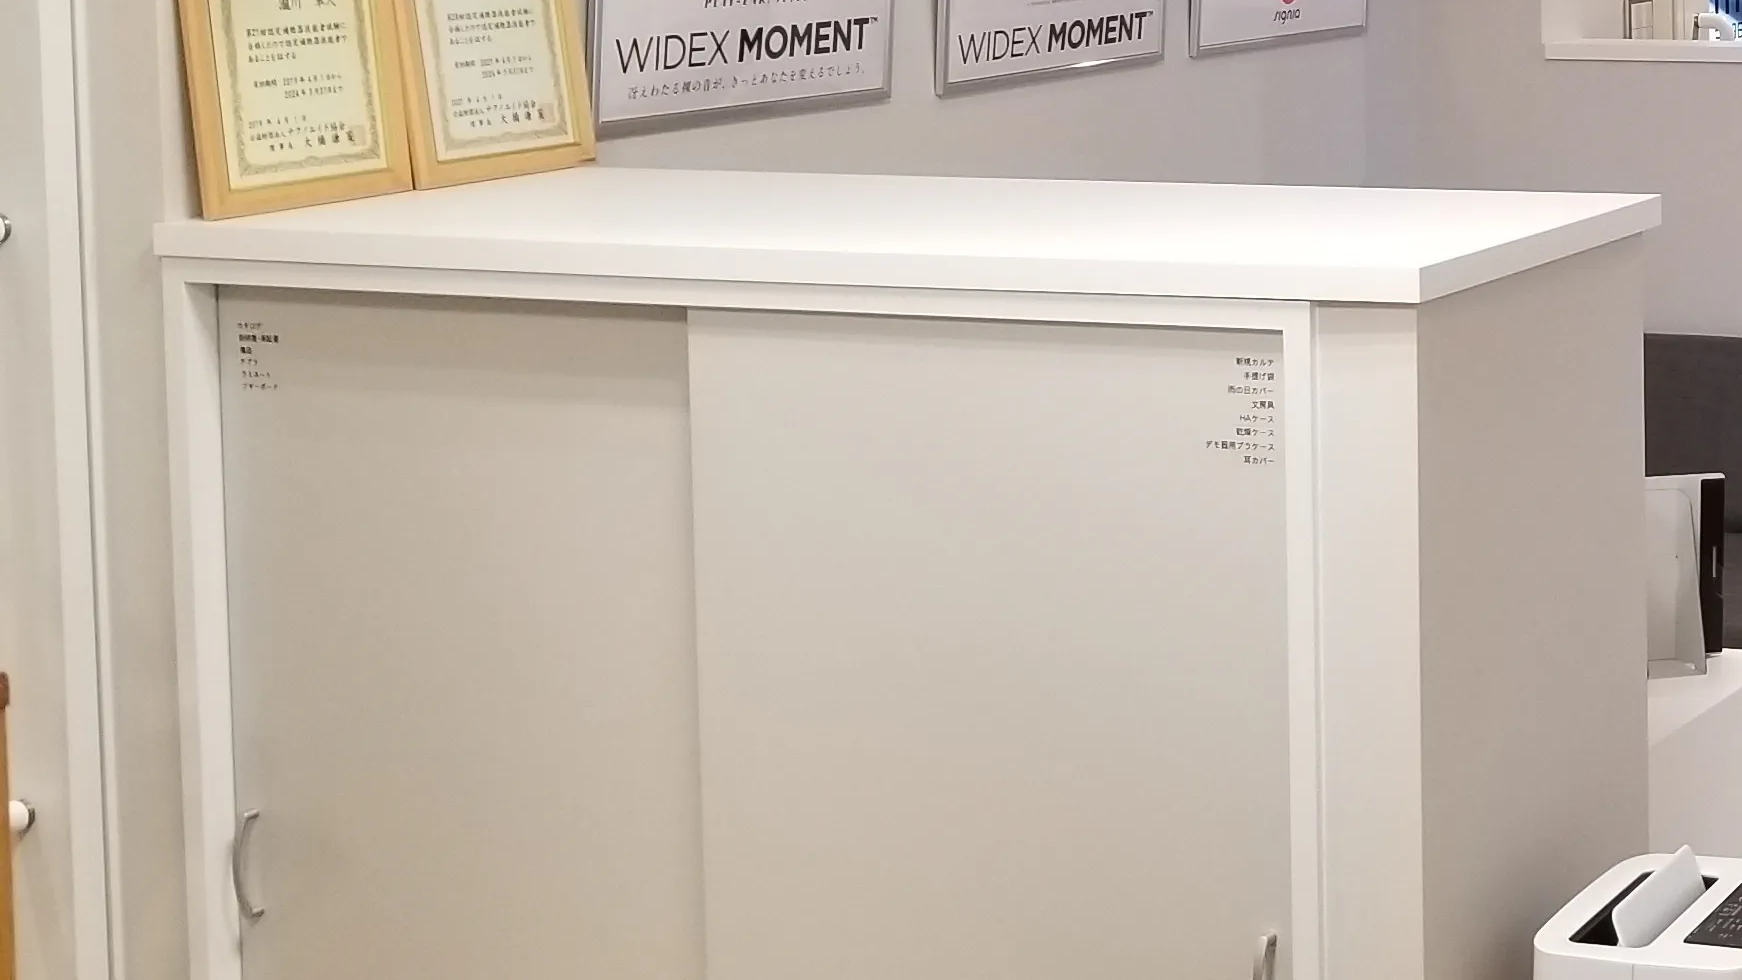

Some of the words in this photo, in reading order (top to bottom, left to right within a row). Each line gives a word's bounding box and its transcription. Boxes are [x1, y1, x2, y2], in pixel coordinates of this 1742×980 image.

[616, 28, 730, 74] WIDEX
[737, 17, 870, 63] MOMENT
[958, 24, 1042, 65] WIDEX
[1048, 12, 1147, 52] MOMENT
